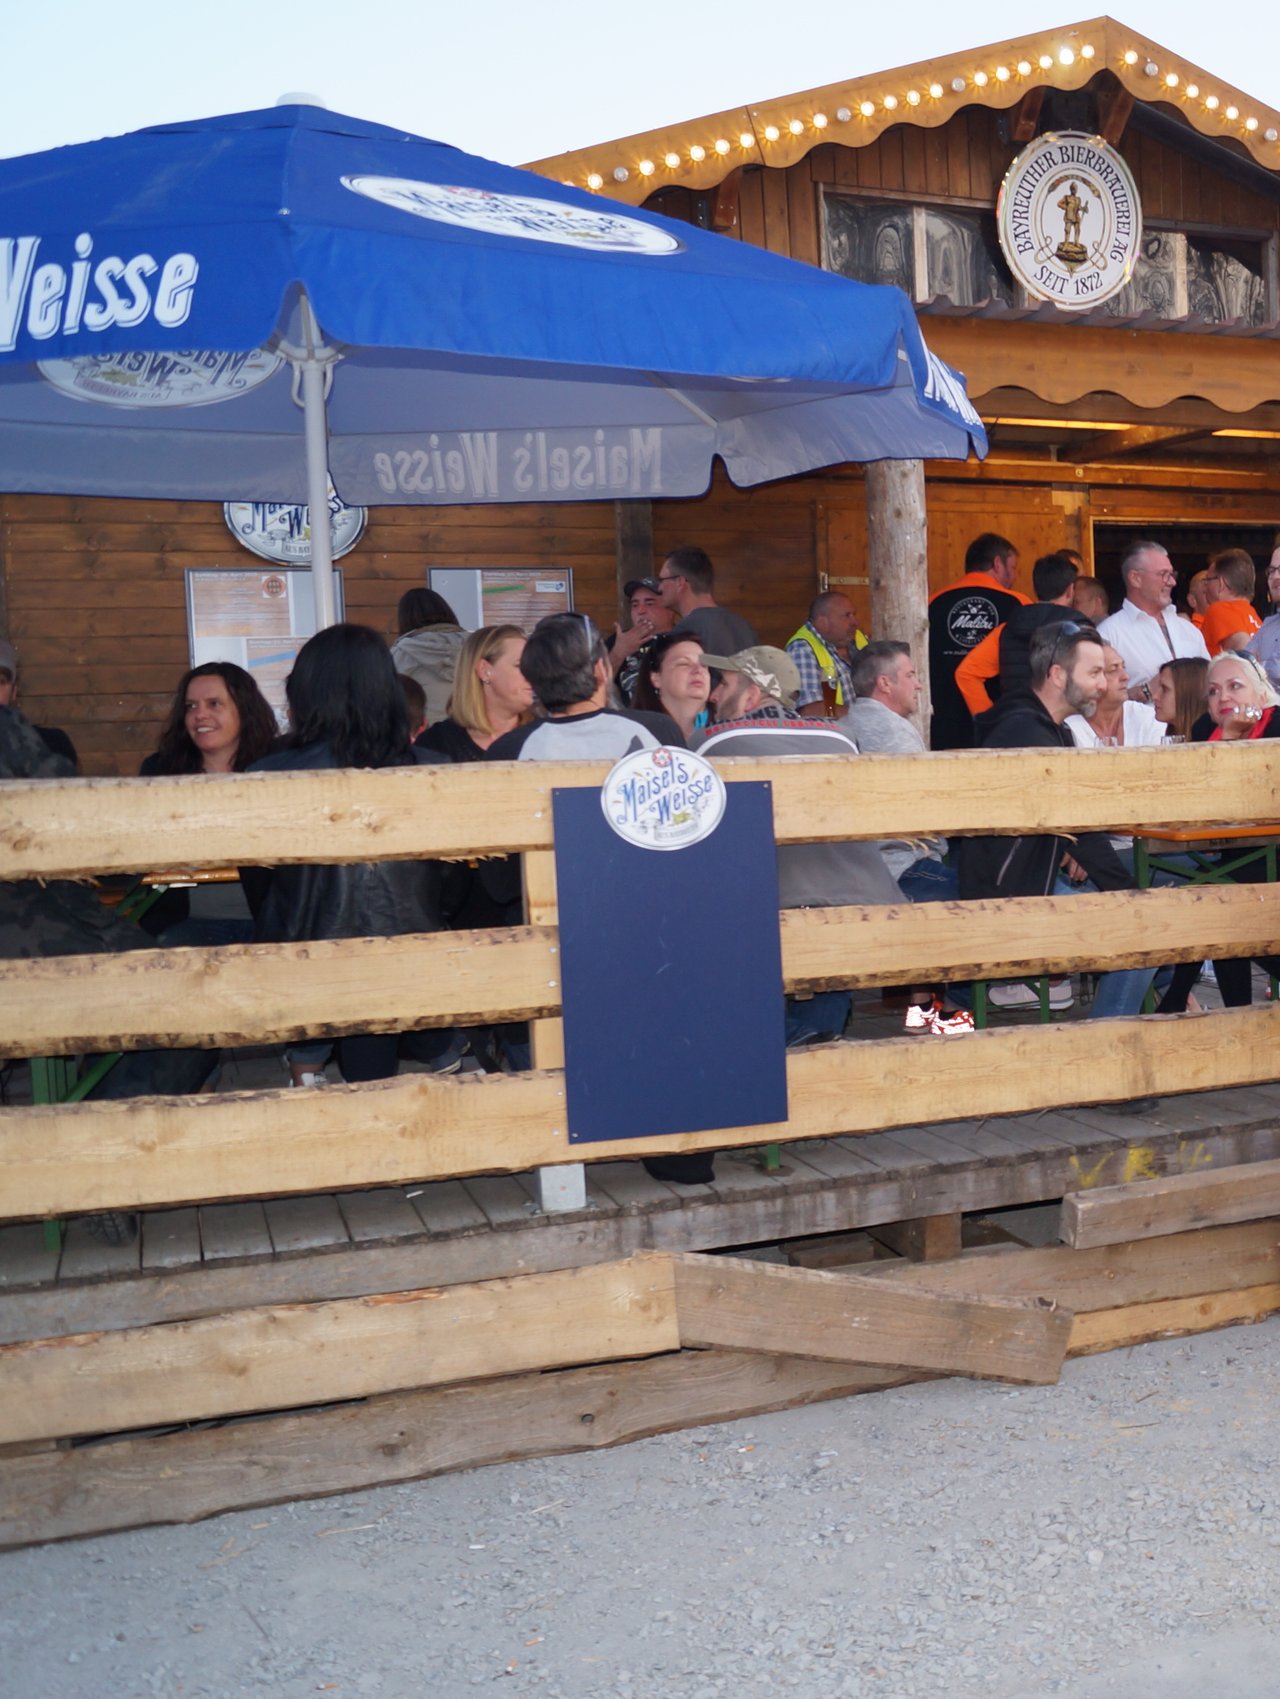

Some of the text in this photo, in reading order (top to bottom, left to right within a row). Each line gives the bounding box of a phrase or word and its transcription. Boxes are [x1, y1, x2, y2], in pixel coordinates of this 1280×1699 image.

[1012, 145, 1131, 264] BAYREUTHER BIERBRAUEREI AG
[1034, 265, 1103, 296] SEIT 1872
[617, 756, 689, 825] Maisel's
[650, 774, 713, 825] Weisse
